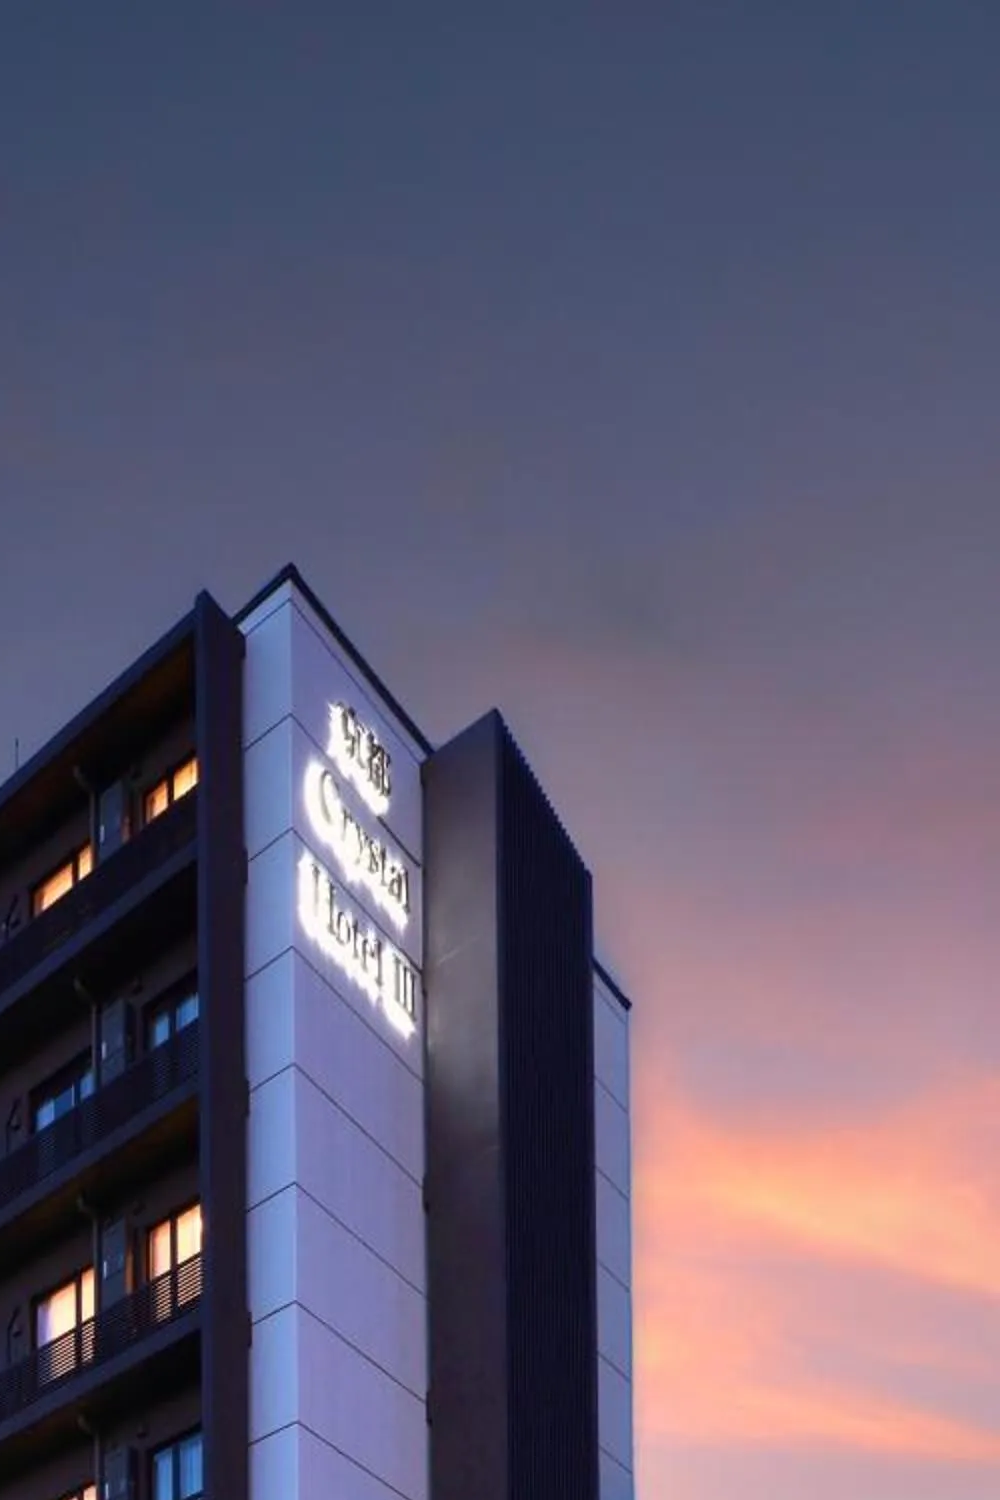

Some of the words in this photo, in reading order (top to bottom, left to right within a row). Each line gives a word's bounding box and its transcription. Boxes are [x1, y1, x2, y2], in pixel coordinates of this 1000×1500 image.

[335, 701, 392, 801] 京都
[313, 766, 411, 918] Crystal
[306, 858, 383, 990] Hotel
